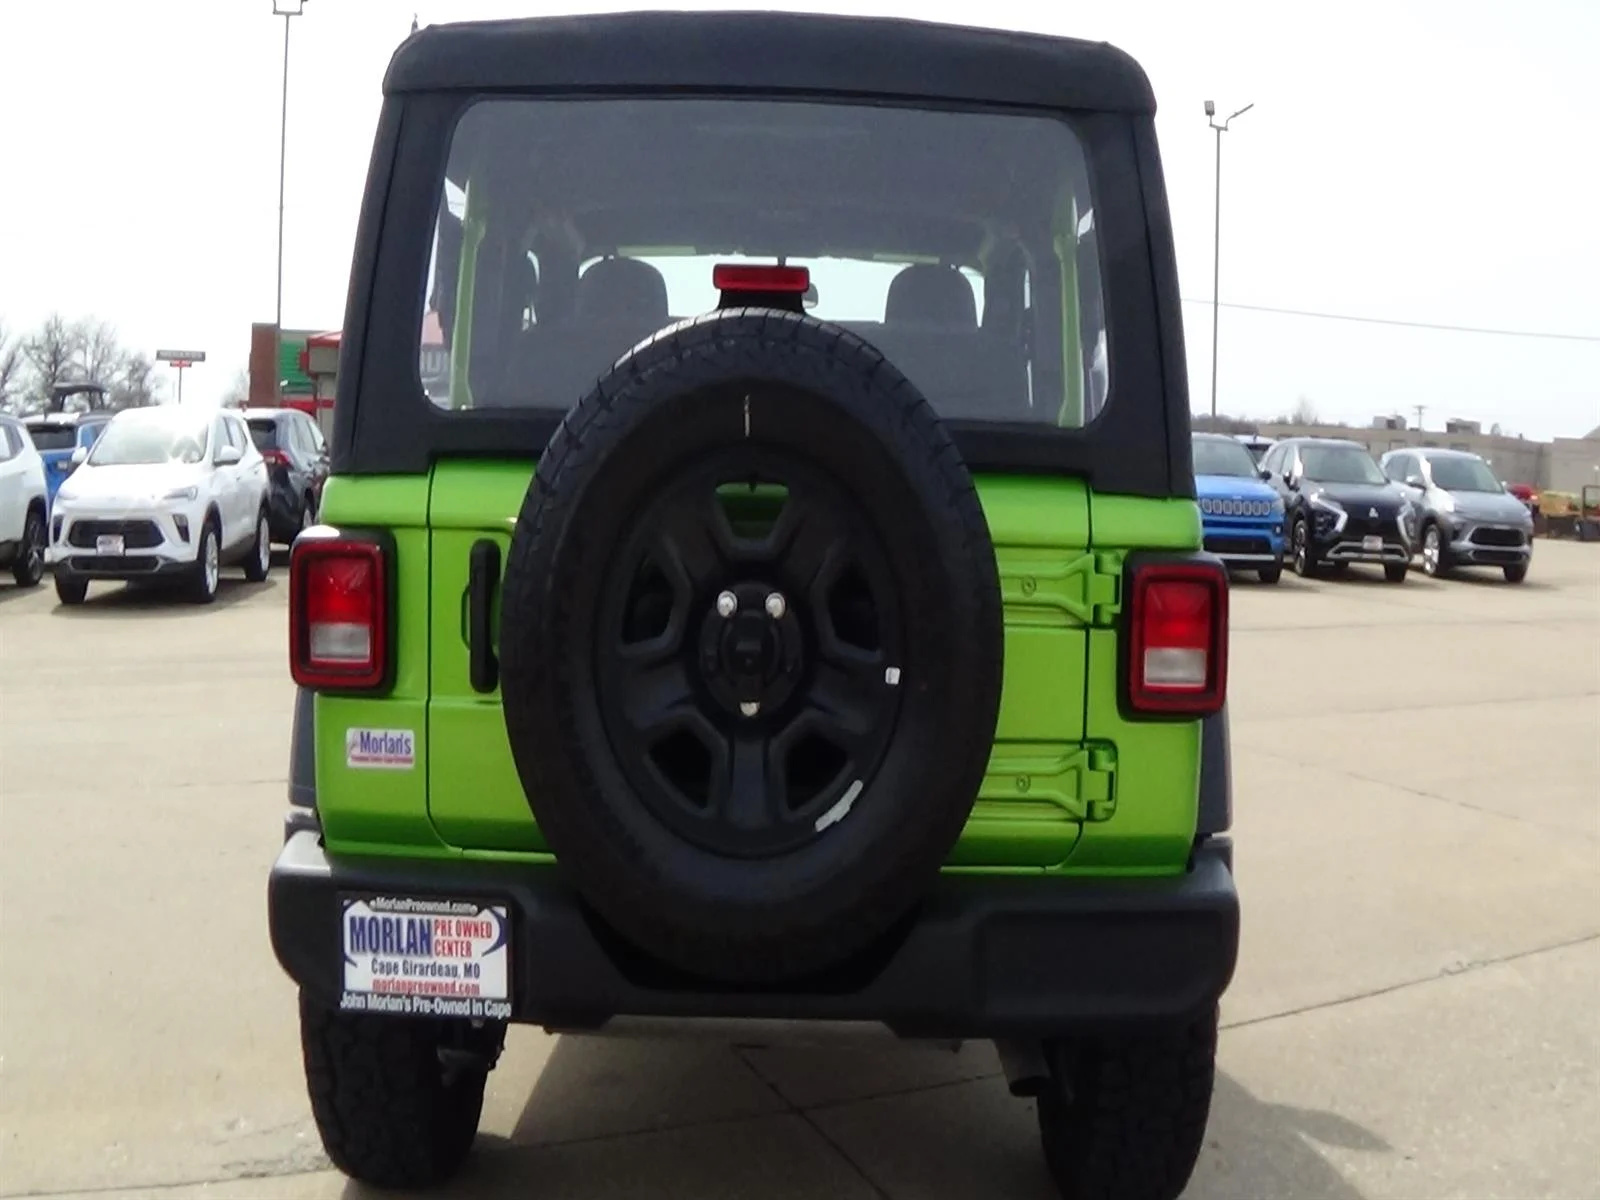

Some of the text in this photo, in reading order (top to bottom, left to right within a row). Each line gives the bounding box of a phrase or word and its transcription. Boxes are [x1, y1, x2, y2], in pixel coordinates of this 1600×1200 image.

[350, 916, 432, 957] MORLAN
[434, 920, 492, 939] PRE OWNED
[434, 939, 472, 957] CENTER
[371, 958, 399, 976] Cape
[463, 962, 481, 979] MO
[341, 992, 366, 1010] John
[367, 994, 411, 1013] Morlan's
[413, 997, 470, 1016] Pre-Owned
[484, 1000, 511, 1020] Cape
